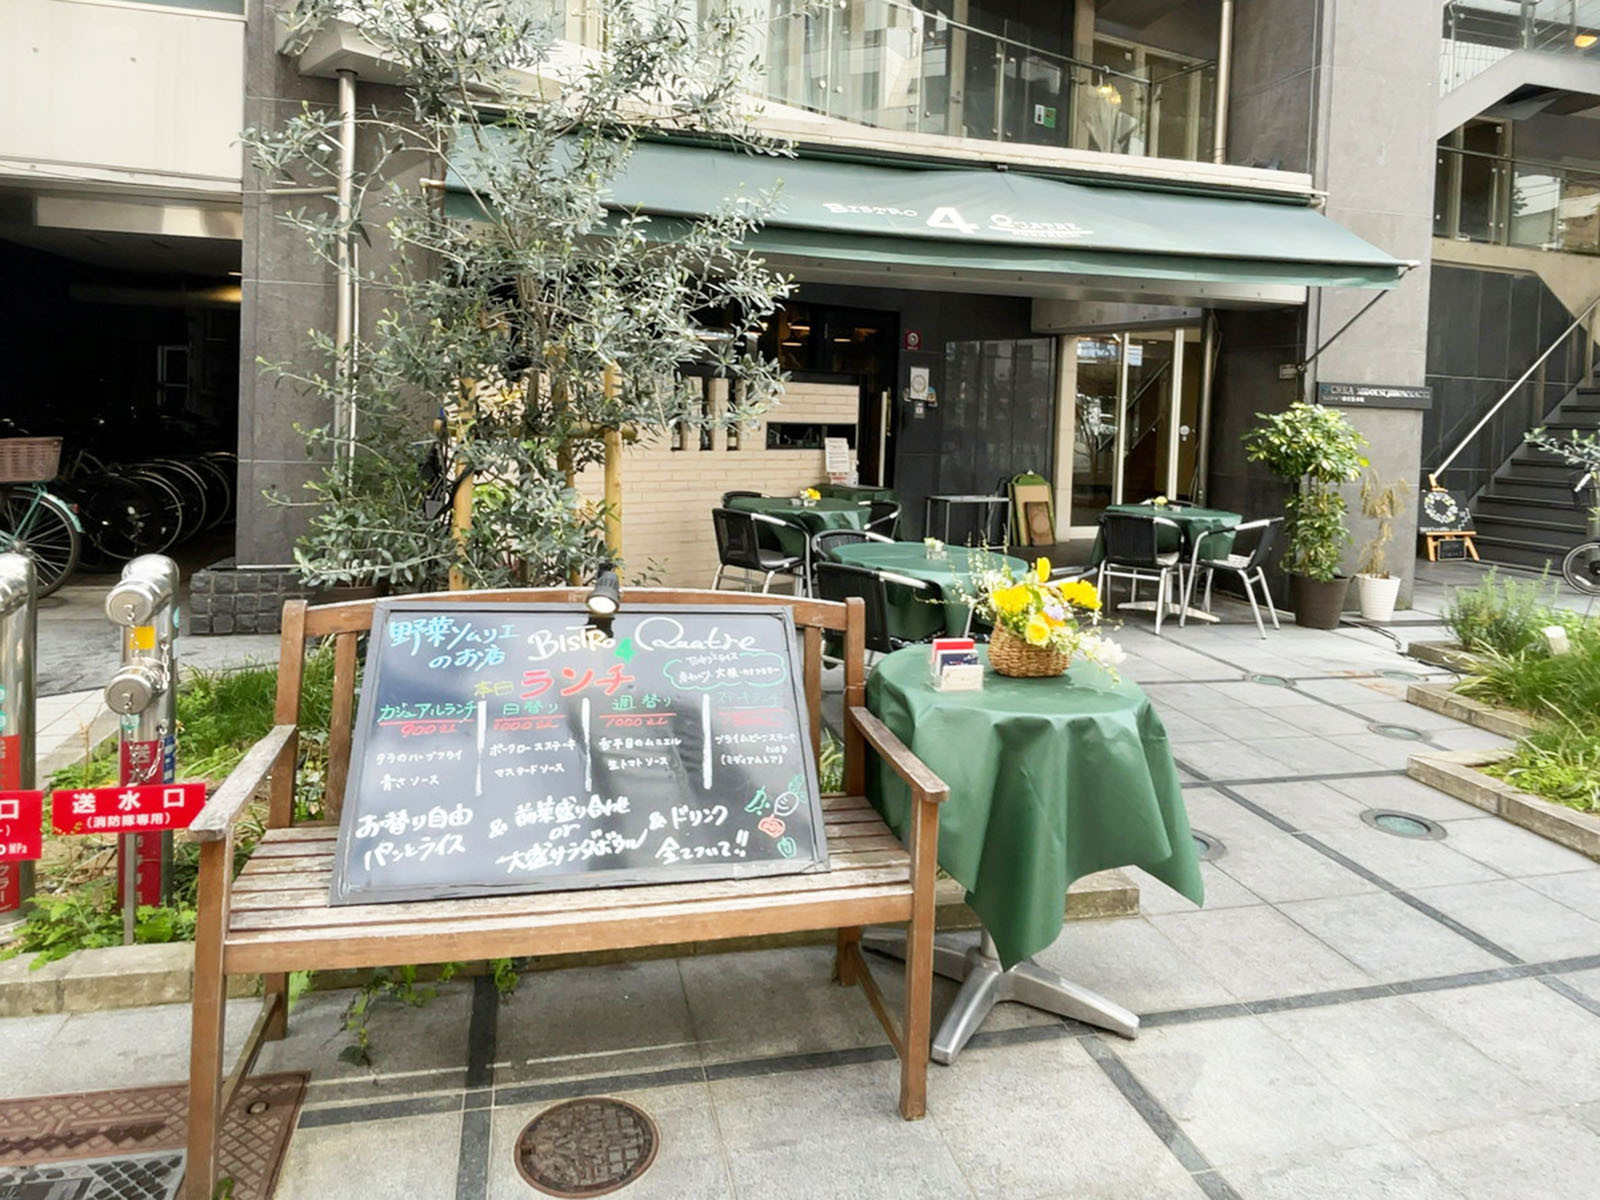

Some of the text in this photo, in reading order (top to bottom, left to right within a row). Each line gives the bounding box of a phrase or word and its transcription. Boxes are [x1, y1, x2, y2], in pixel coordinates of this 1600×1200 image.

[822, 202, 918, 218] BISTRO
[926, 206, 980, 234] 4
[635, 616, 766, 652] Quatre
[520, 663, 636, 699] ランチ
